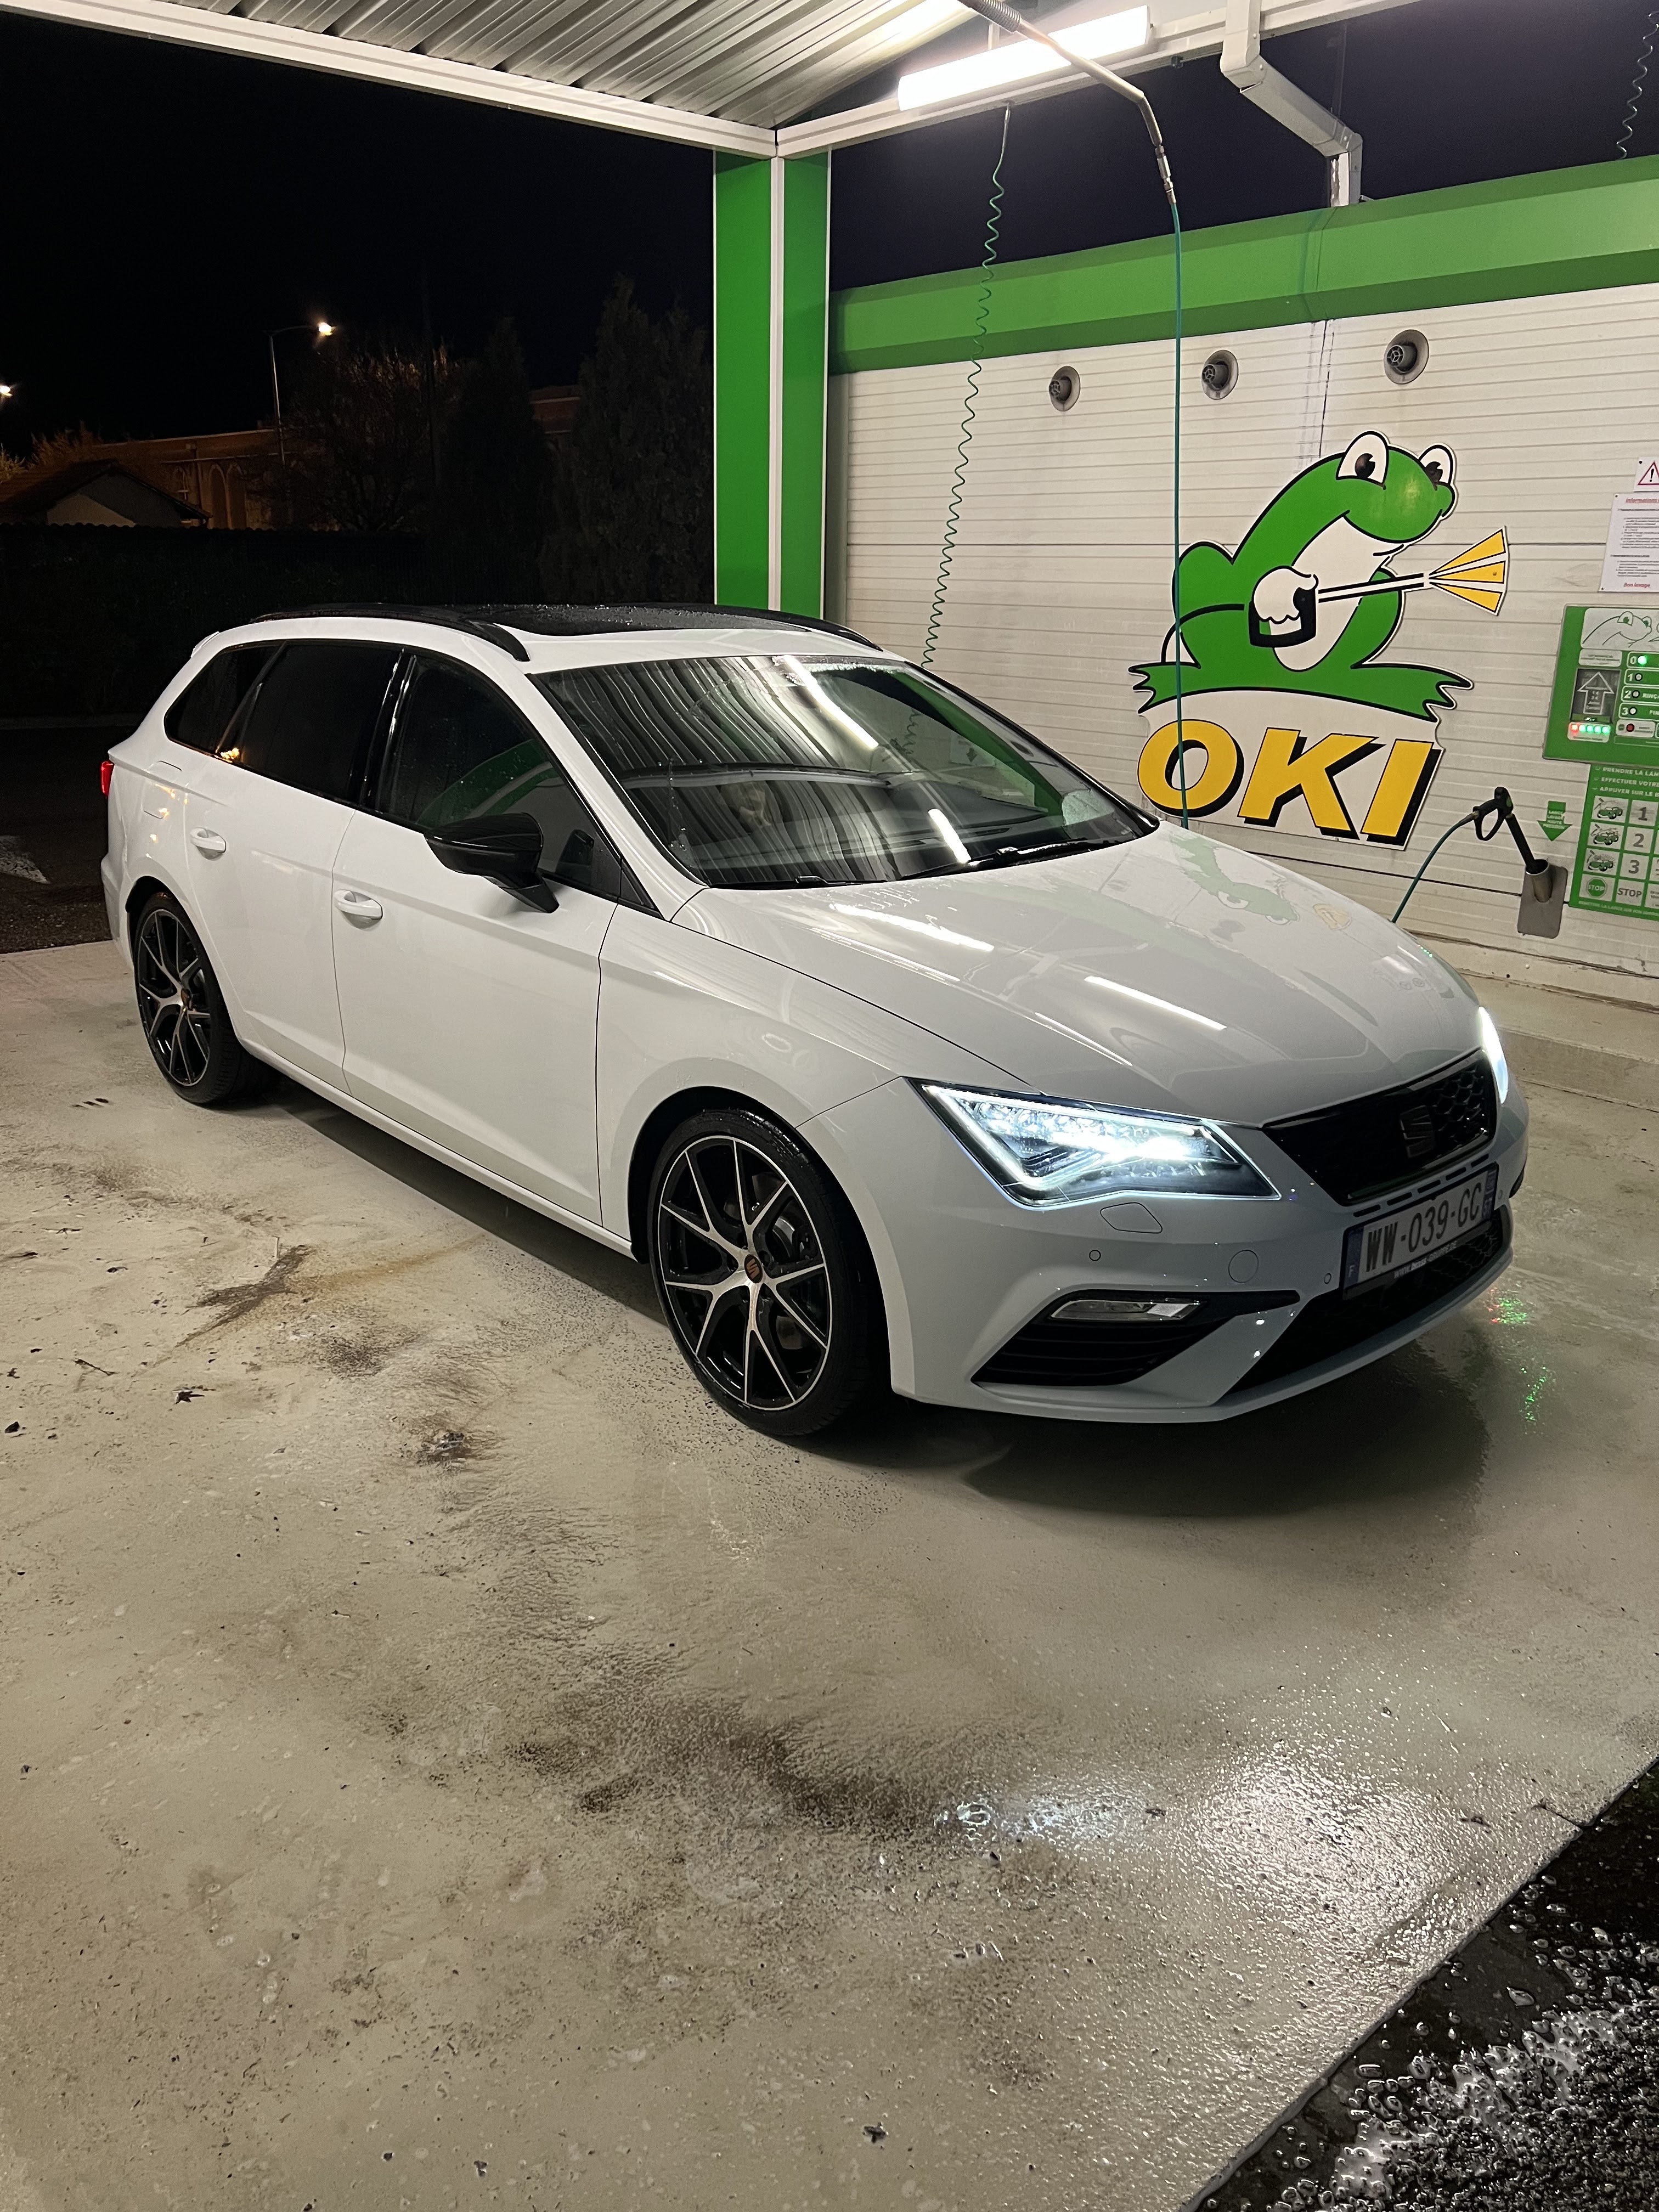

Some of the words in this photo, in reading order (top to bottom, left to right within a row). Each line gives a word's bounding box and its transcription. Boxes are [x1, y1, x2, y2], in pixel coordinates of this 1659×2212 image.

[1630, 656, 1637, 665] 0
[1628, 673, 1633, 681] 1
[1624, 690, 1632, 698] 2
[1621, 707, 1628, 715] 3
[1138, 719, 1441, 845] OKI
[1601, 777, 1637, 785] EFFECTUER
[1600, 786, 1629, 794] APPUYER
[1638, 806, 1647, 821] 1
[1633, 833, 1645, 848] 2
[1628, 860, 1640, 874] 3
[1617, 888, 1642, 898] STOP
[1366, 1182, 1481, 1273] WW-039-GC
[1348, 1264, 1356, 1278] F
